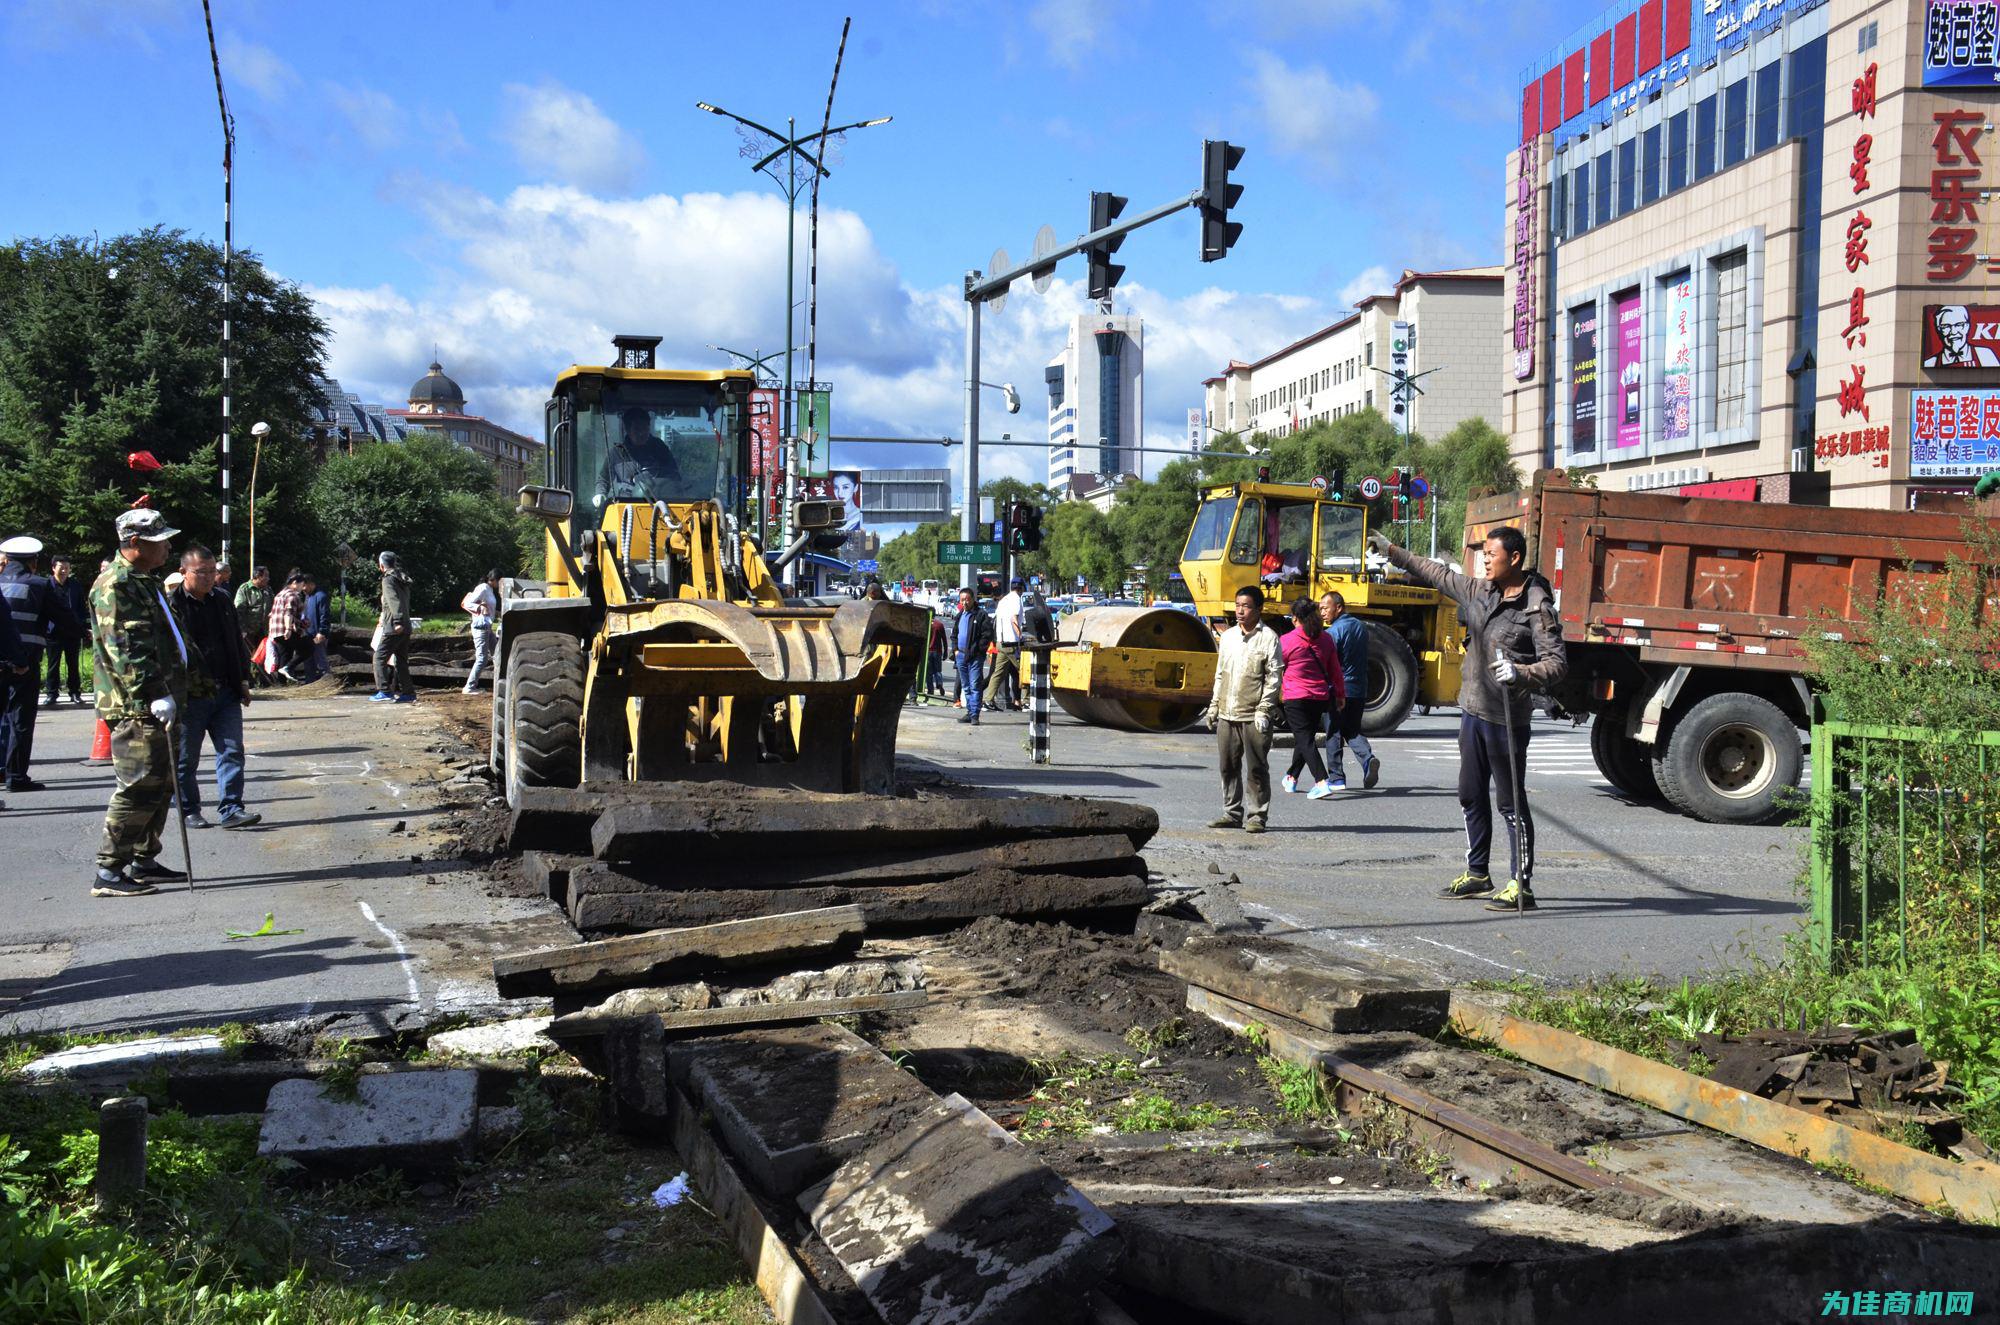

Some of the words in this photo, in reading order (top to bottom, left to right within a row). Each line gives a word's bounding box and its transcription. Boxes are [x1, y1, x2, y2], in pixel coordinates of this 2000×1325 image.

[1926, 108, 1986, 282] 衣乐多
[1364, 482, 1379, 494] 40
[946, 544, 992, 555] 通河路
